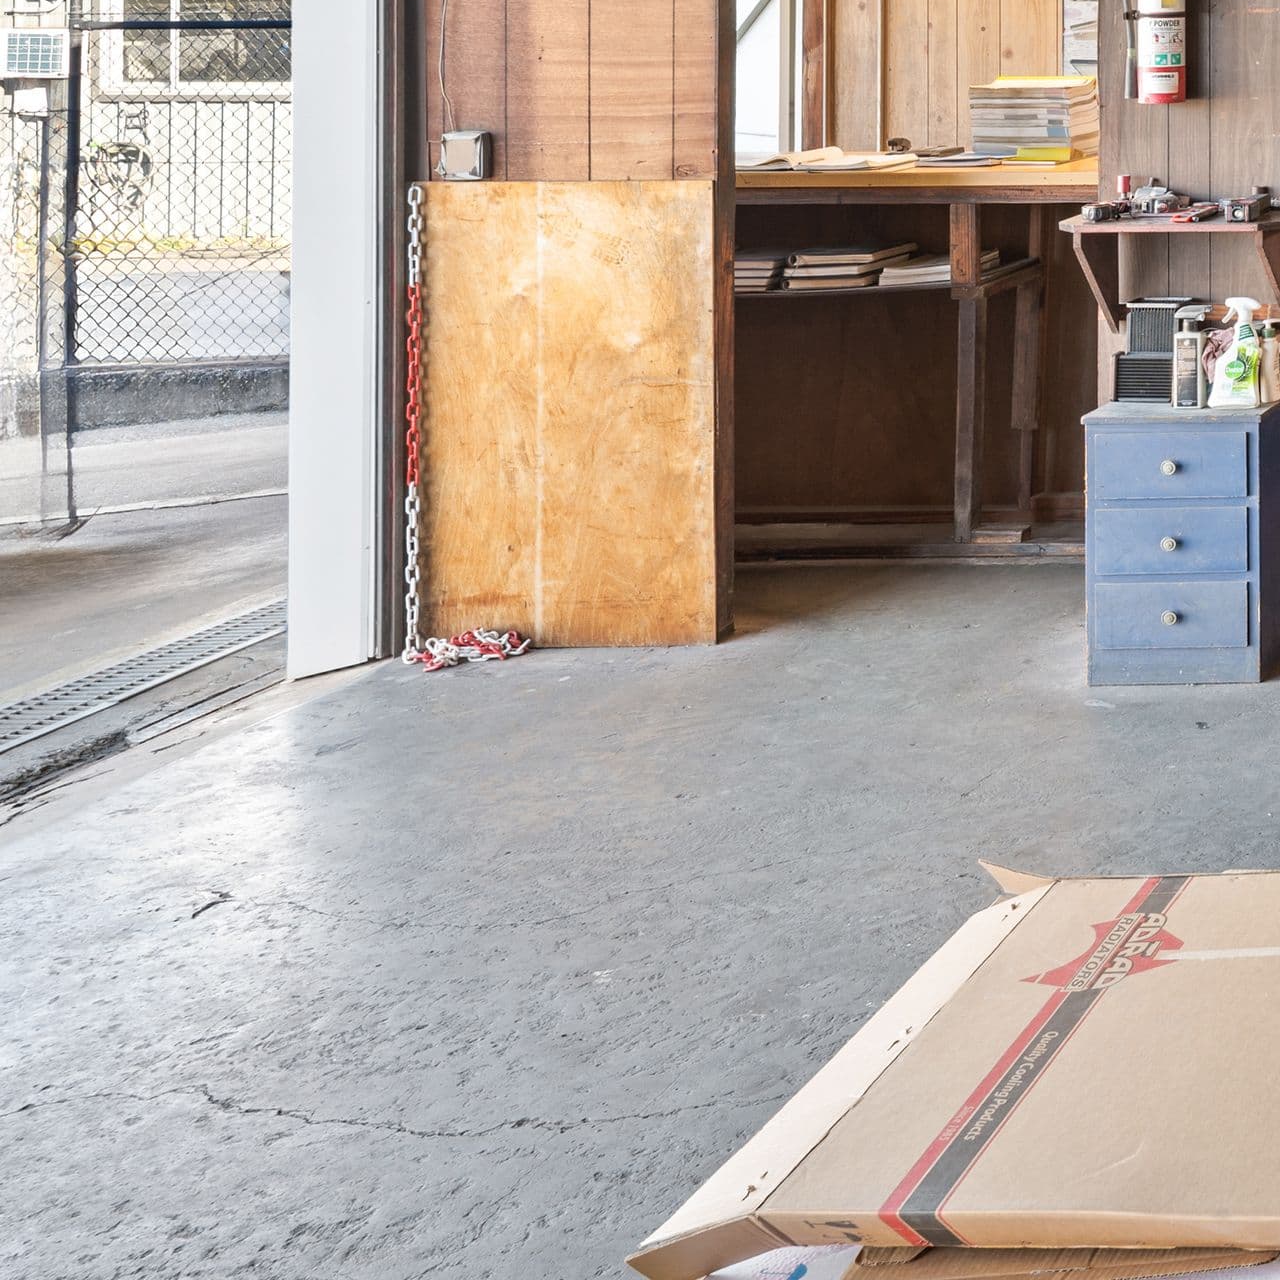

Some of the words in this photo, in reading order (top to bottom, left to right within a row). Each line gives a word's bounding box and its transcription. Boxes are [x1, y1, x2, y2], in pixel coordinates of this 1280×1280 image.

[1153, 19, 1180, 27] POWDER
[1071, 917, 1134, 988] RADIATORS
[1092, 913, 1167, 990] ADRAD
[1023, 1031, 1059, 1062] Quality
[994, 1062, 1034, 1098] Cooling
[964, 1098, 1007, 1141] Products
